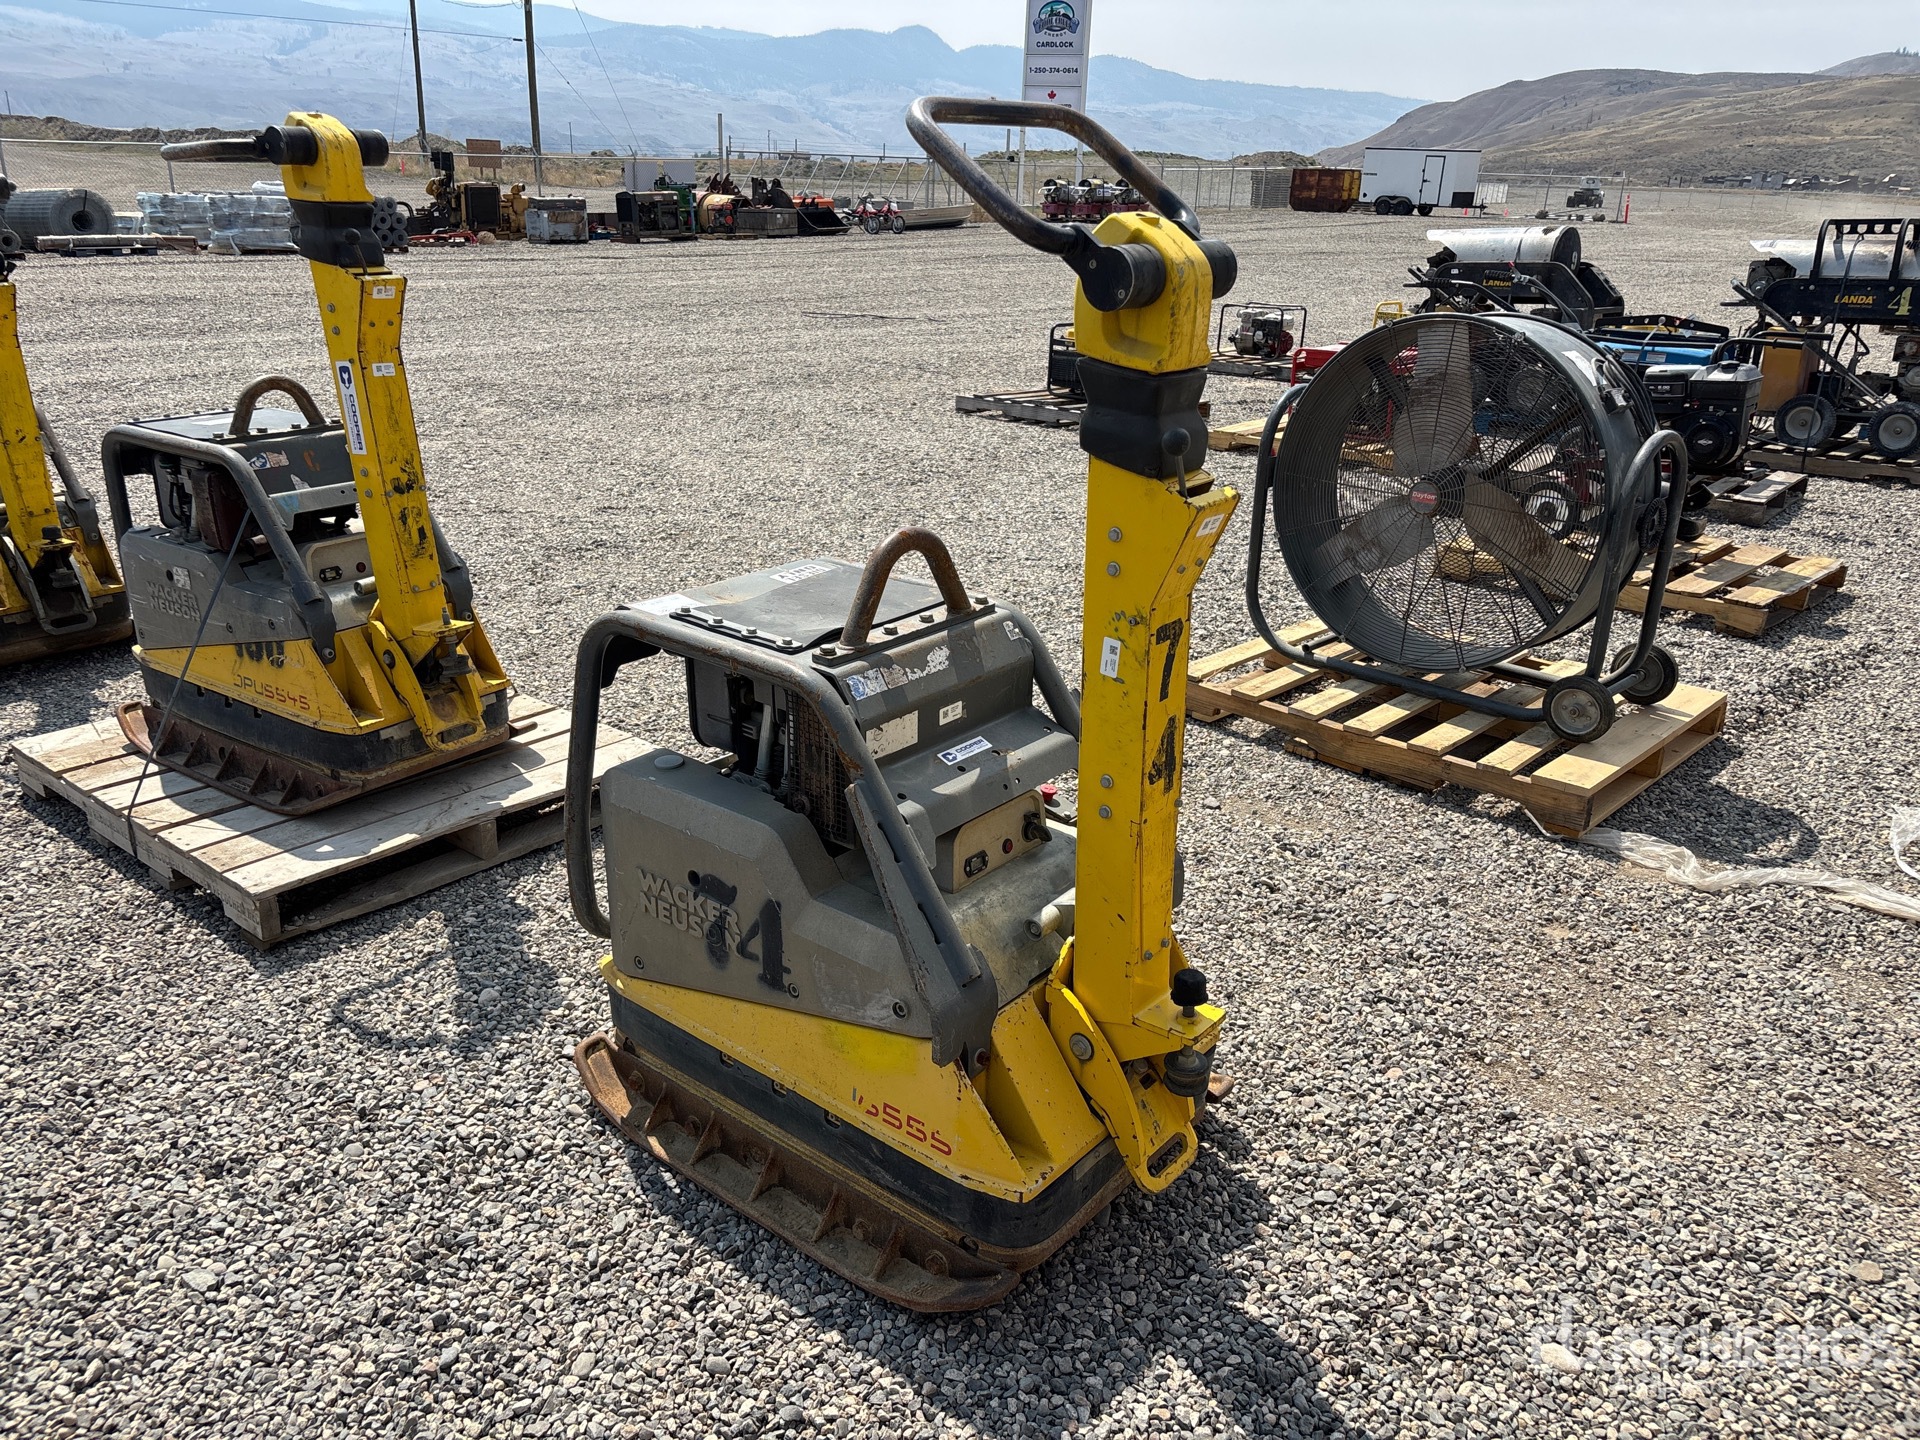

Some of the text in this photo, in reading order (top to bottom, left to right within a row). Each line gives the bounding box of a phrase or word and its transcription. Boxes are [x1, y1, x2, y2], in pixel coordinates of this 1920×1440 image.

[1570, 251, 1578, 271] 9
[1887, 286, 1912, 316] 4
[349, 393, 363, 451] COOPER
[146, 582, 199, 609] WACKER
[150, 597, 201, 622] NEUSON
[955, 738, 985, 754] COOPER
[636, 866, 742, 937] WACKER
[640, 890, 744, 958] NEUSON
